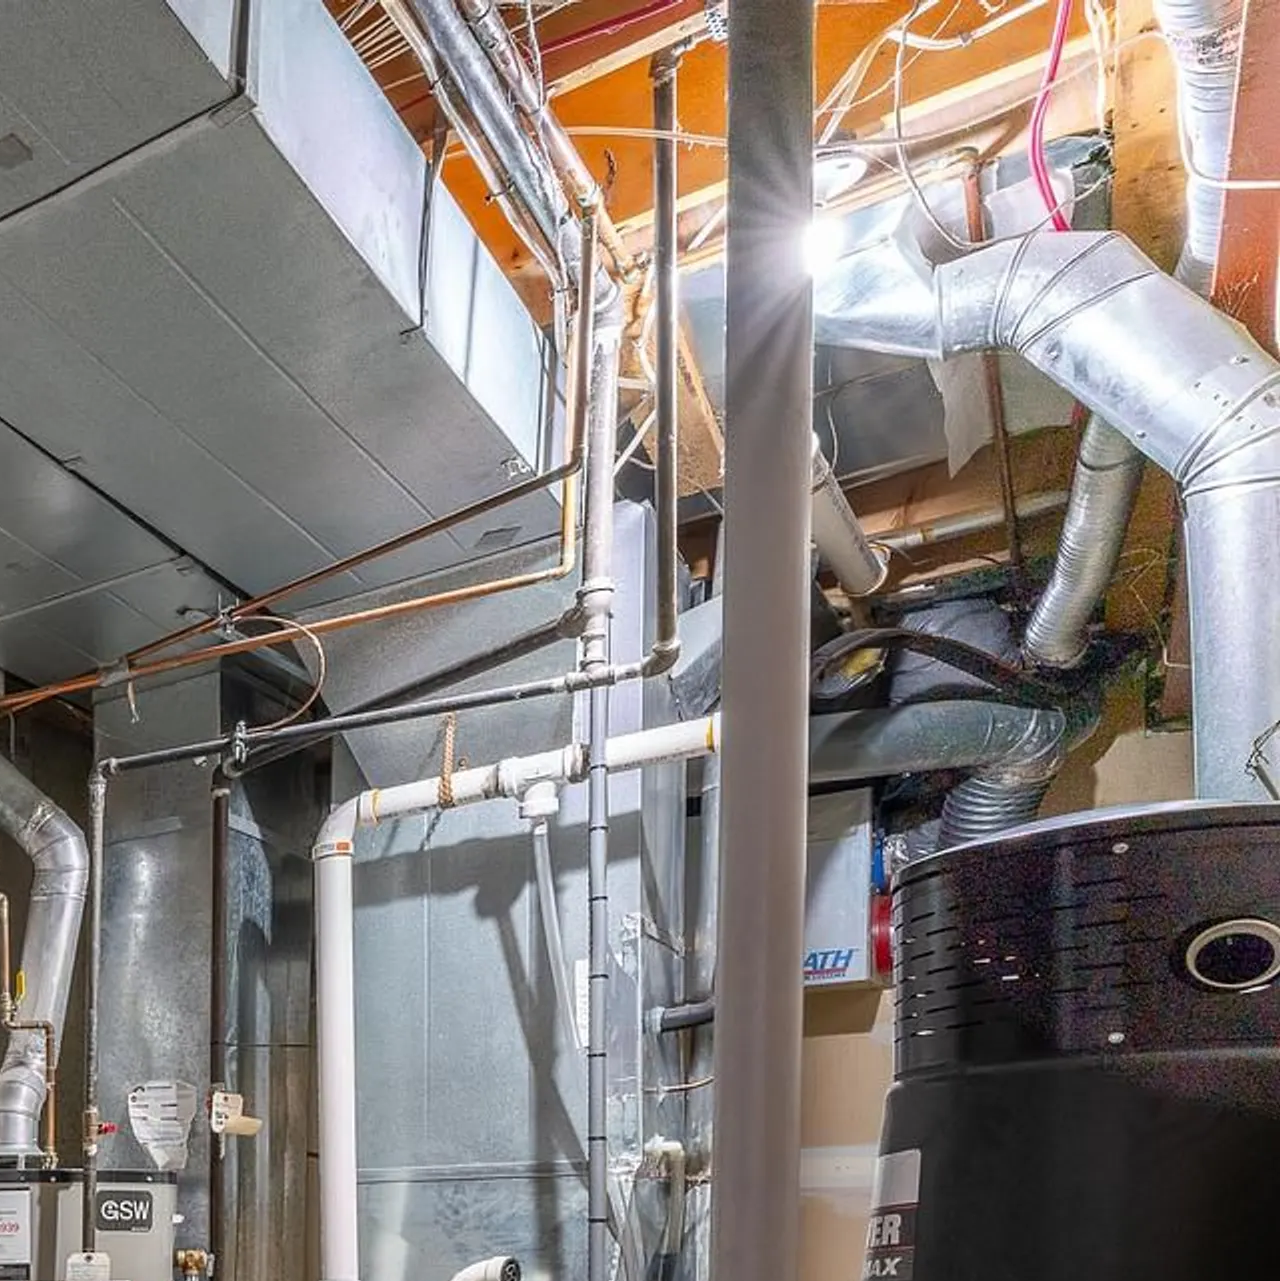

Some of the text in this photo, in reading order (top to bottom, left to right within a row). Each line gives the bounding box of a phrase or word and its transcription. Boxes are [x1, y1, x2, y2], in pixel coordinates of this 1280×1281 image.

[804, 949, 853, 969] ATH
[101, 1200, 149, 1220] GSW
[866, 1214, 901, 1249] ER
